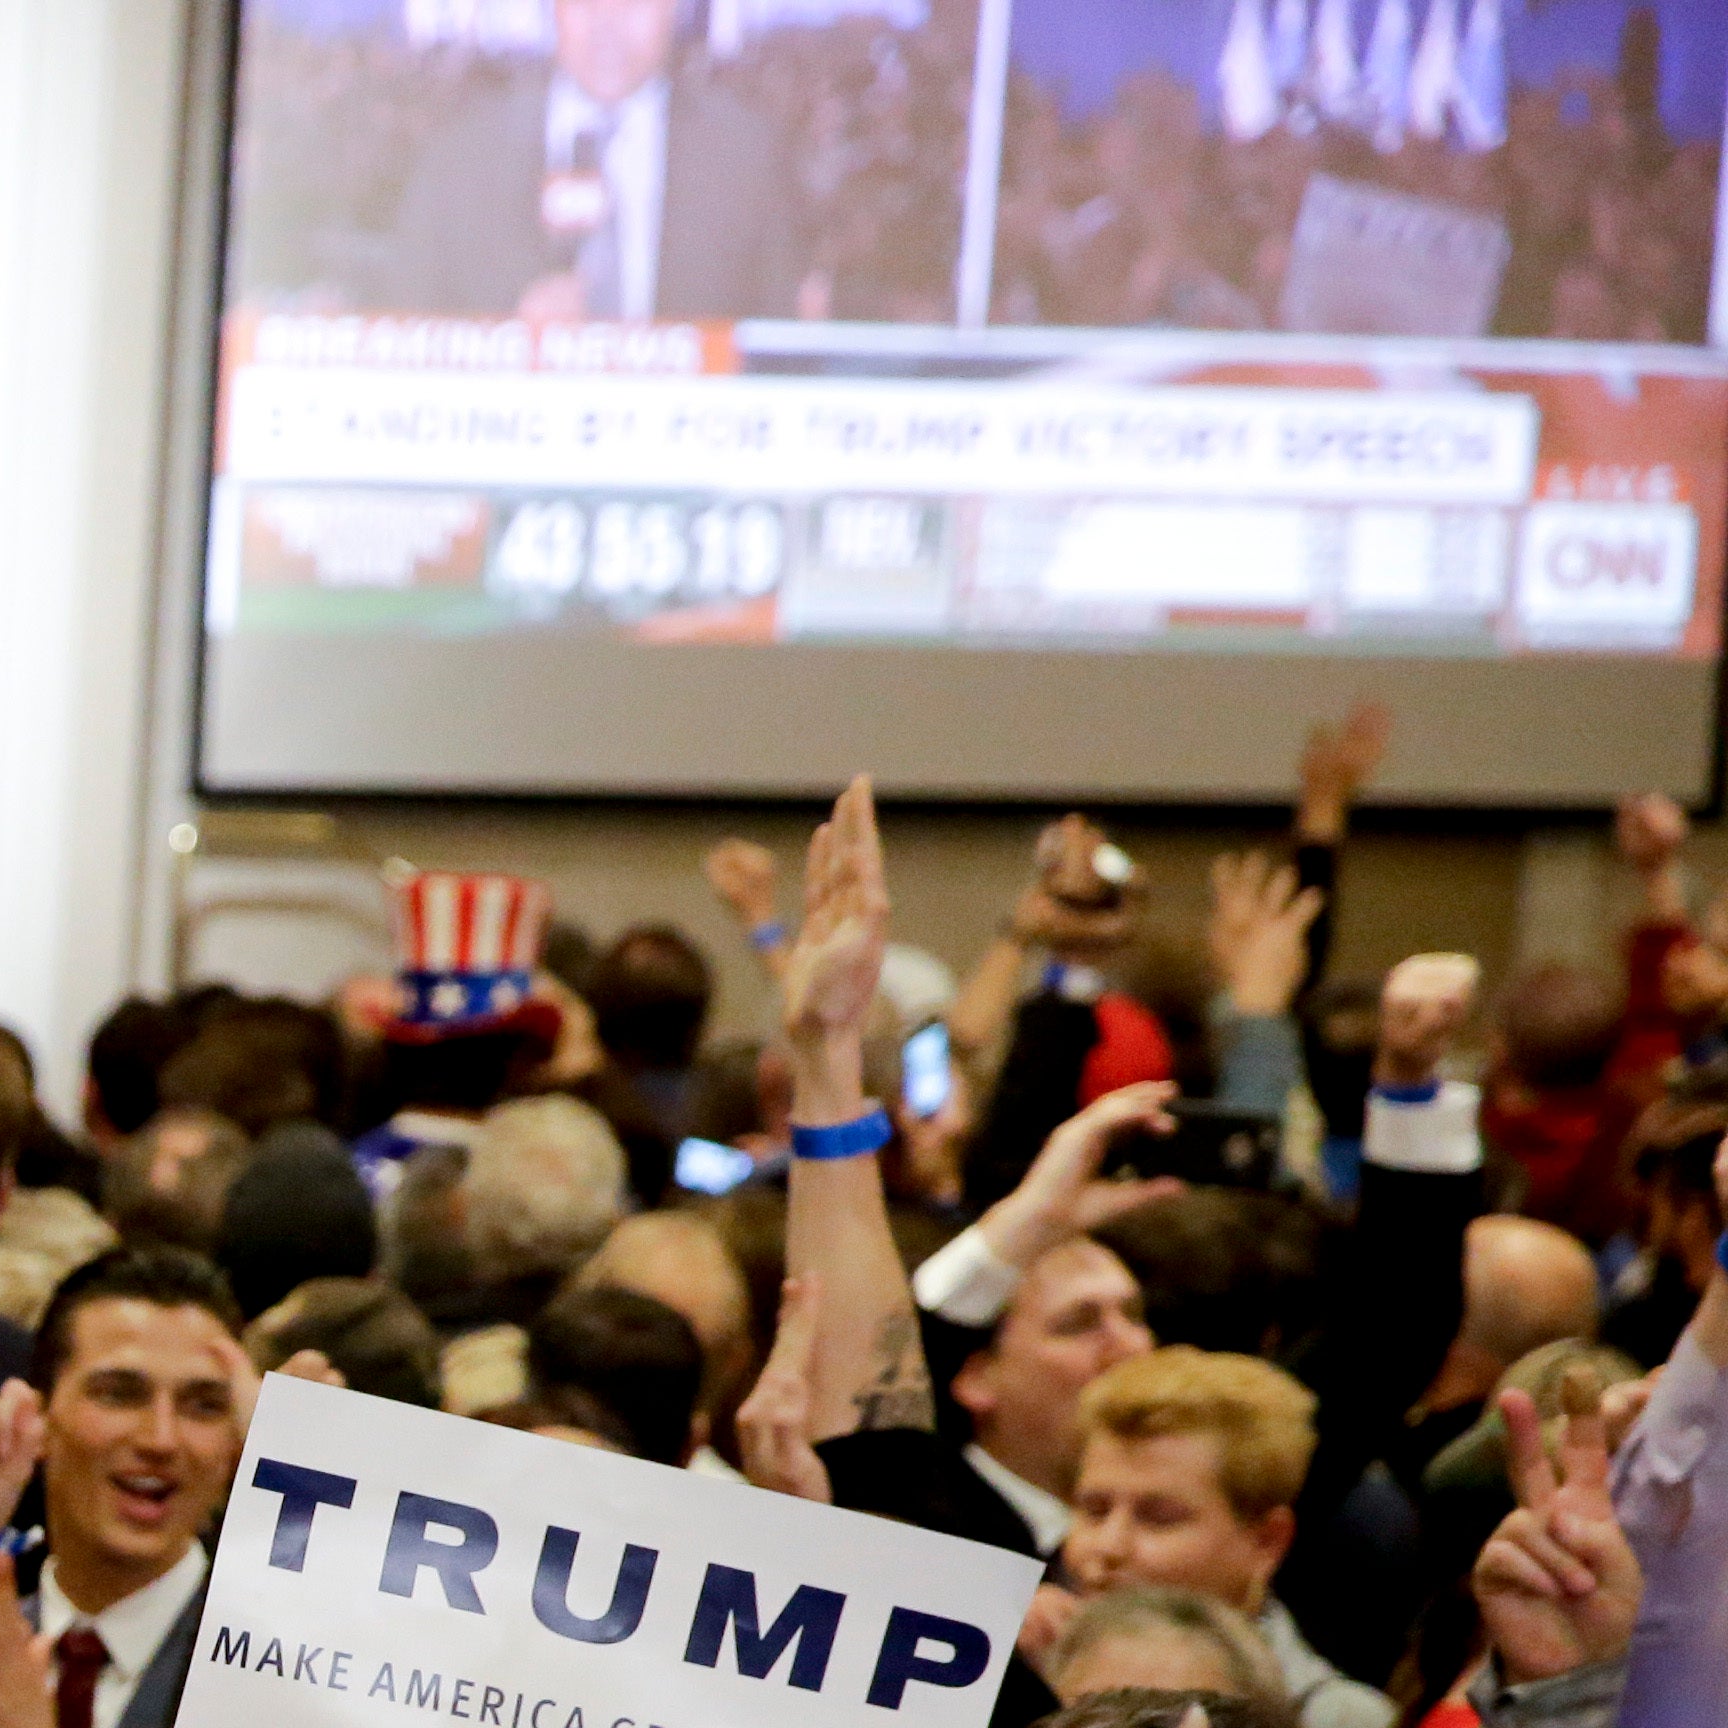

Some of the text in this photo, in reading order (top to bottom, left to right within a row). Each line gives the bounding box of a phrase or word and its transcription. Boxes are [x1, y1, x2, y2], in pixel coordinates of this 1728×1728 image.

[1276, 412, 1498, 473] SPEECH
[1545, 536, 1666, 591] CNN
[250, 1457, 992, 1712] TRUMP
[209, 1626, 351, 1692] MAKE
